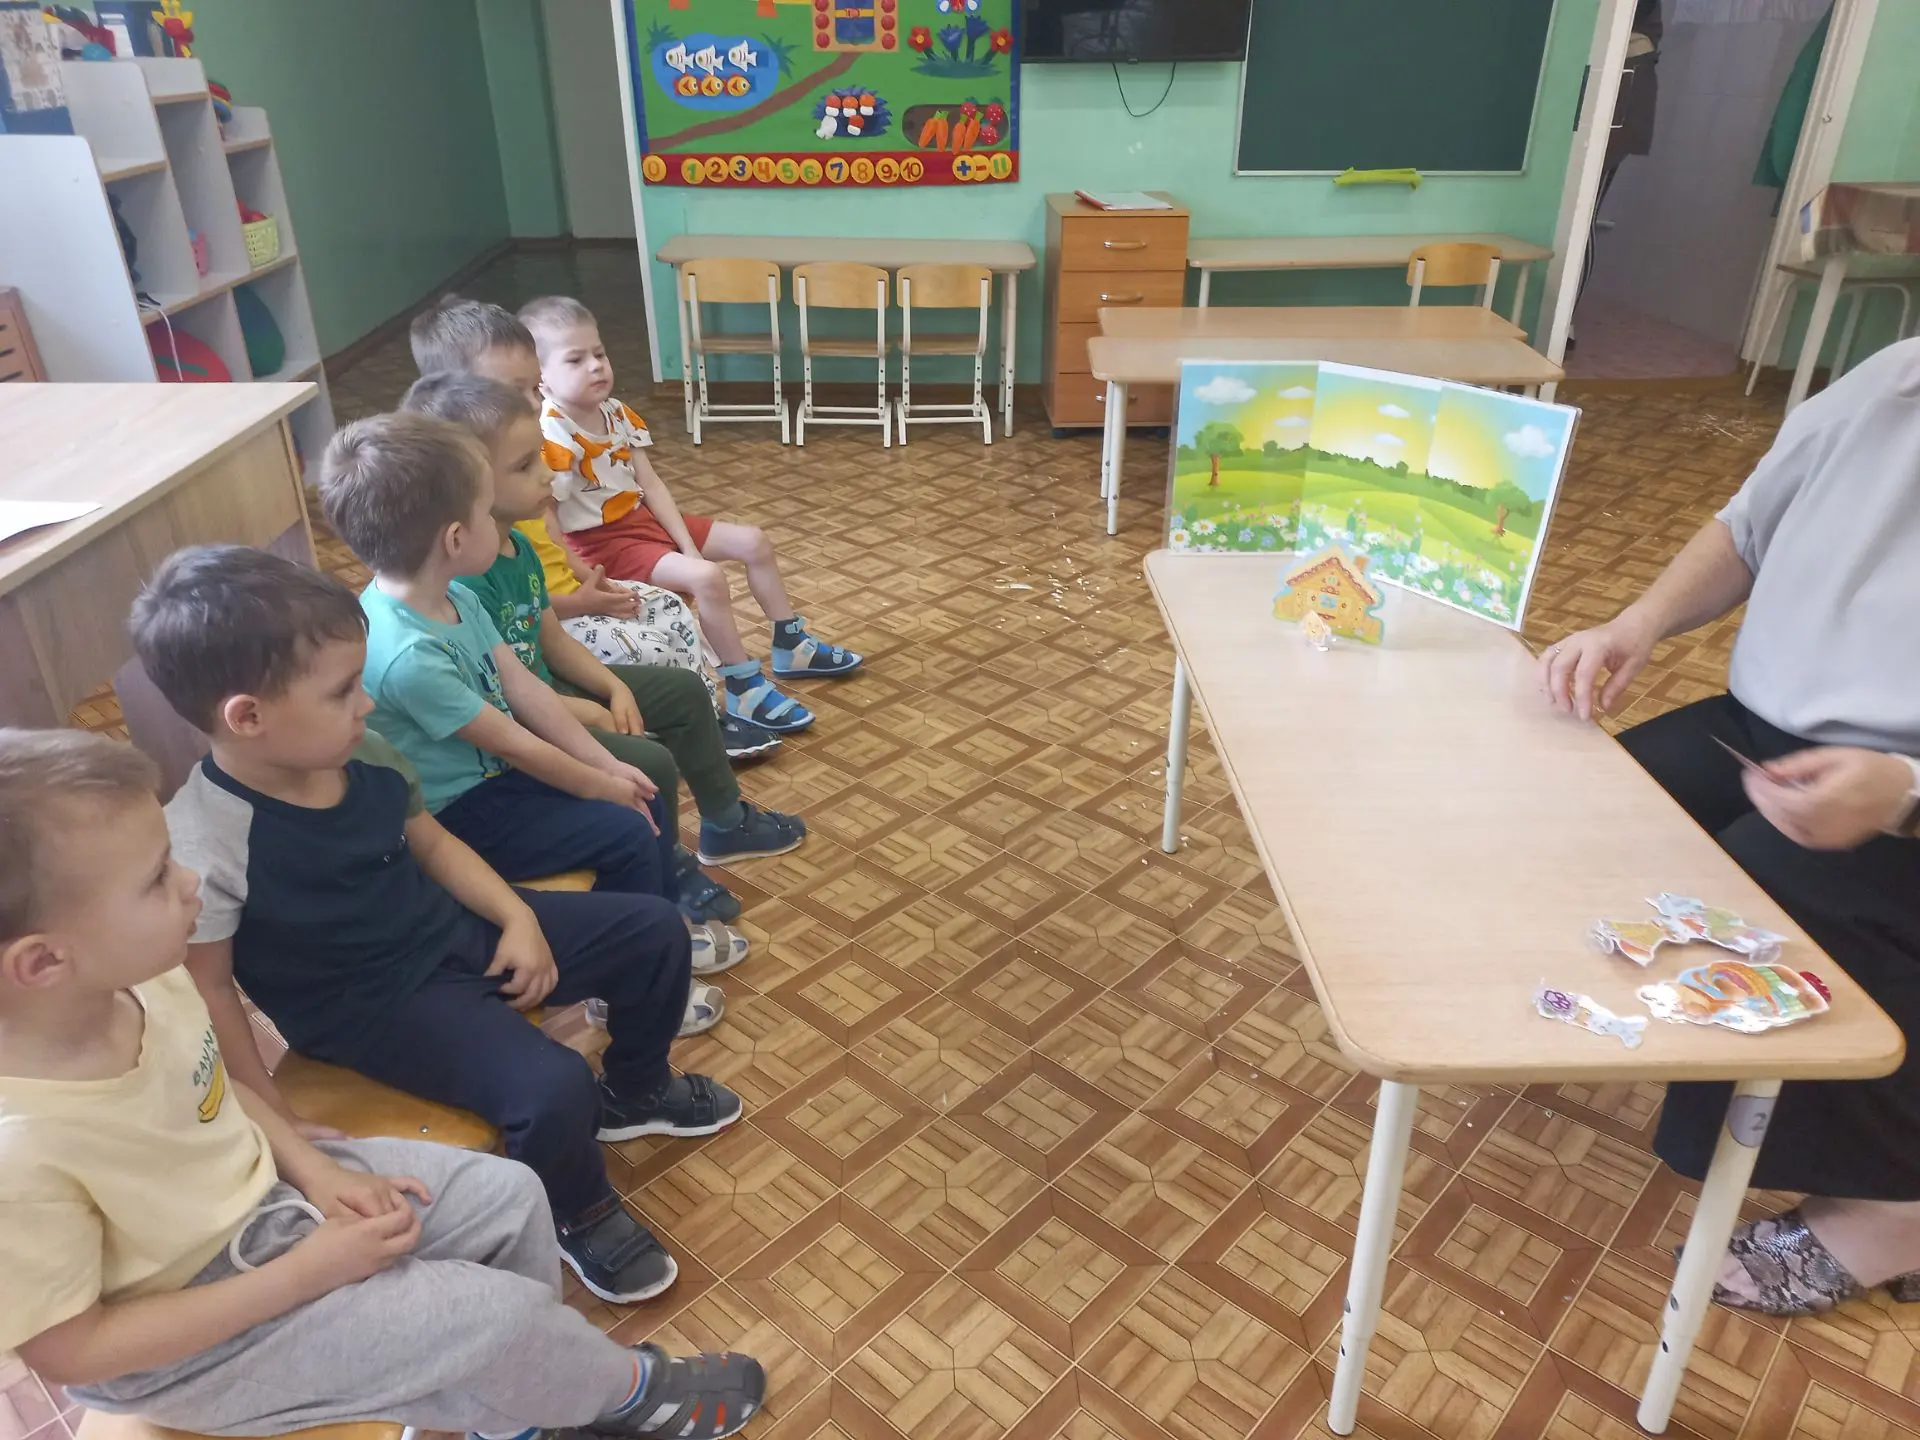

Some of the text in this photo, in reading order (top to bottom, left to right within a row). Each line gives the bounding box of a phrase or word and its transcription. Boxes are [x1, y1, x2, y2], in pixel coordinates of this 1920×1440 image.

[647, 160, 661, 176] 0
[687, 163, 697, 180] 1
[710, 161, 722, 177] 2
[734, 160, 747, 177] 3
[757, 161, 770, 177] 4
[781, 163, 794, 180] 5
[830, 162, 843, 180] 7
[857, 162, 869, 180] 8
[902, 162, 921, 178] 10
[1750, 1112, 1768, 1132] 2
